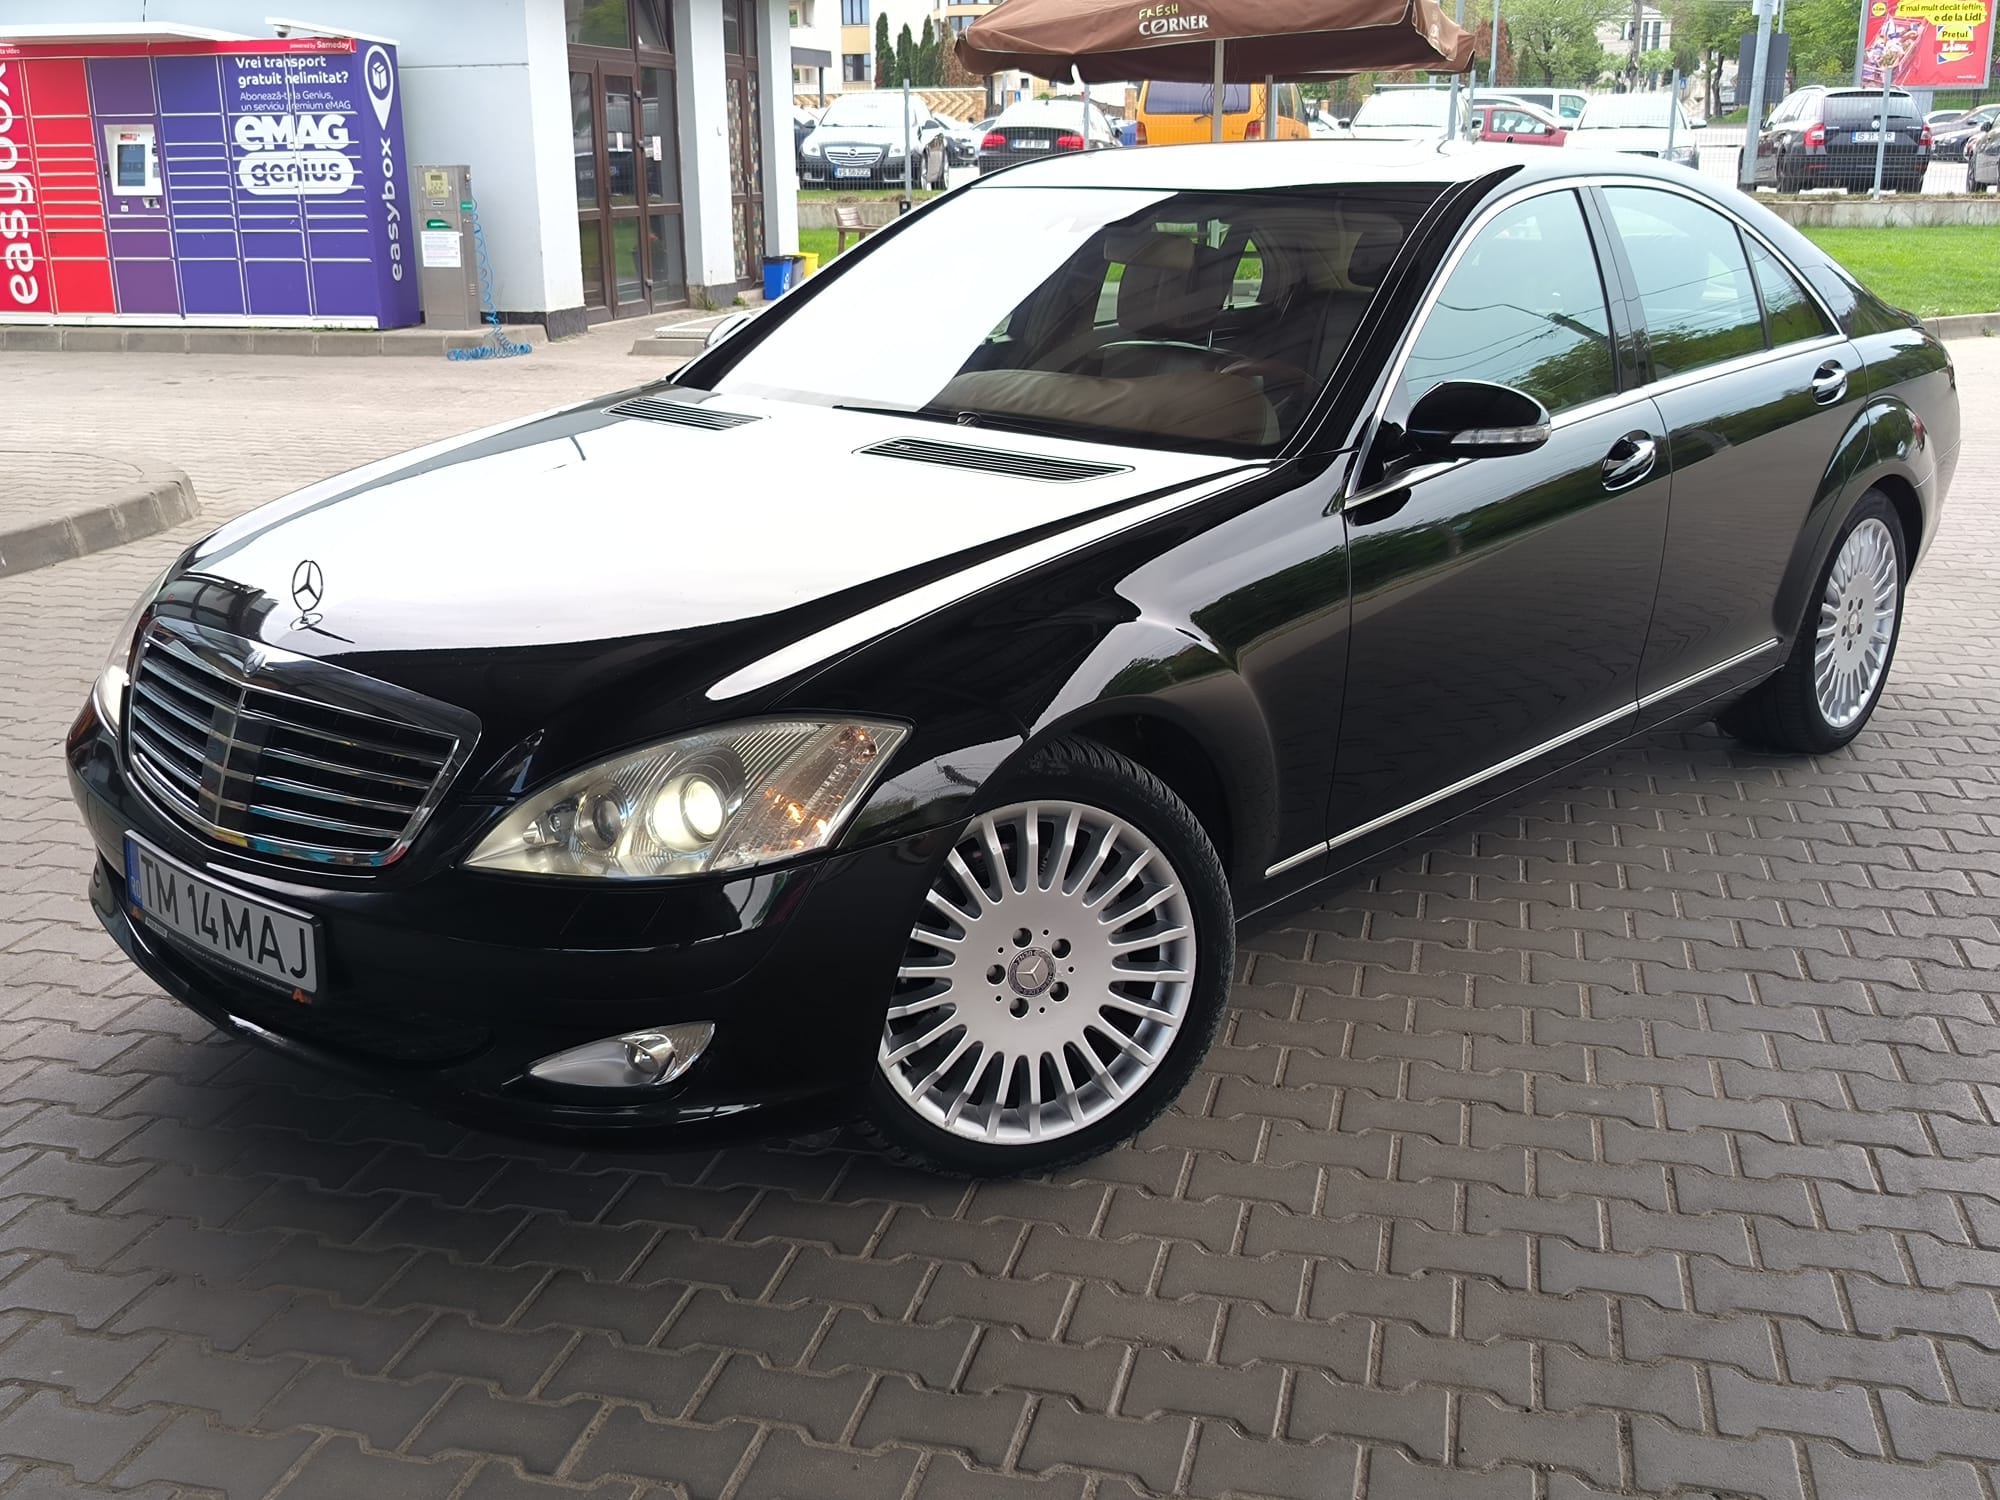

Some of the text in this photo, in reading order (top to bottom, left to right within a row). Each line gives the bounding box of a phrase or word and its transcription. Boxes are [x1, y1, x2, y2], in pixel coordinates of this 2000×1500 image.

[1138, 3, 1179, 20] FRESH
[1964, 12, 1982, 21] Lidl
[1138, 14, 1209, 36] CORNER
[316, 41, 350, 50] Sameday
[235, 56, 326, 70] Vrei transport
[238, 71, 349, 88] gratuit nelimitat?
[302, 90, 334, 101] Genius,
[254, 102, 284, 111] serviciu
[326, 100, 351, 110] eMAG
[234, 114, 350, 150] eMAG
[250, 158, 342, 186] genius
[380, 138, 402, 281] easybox
[140, 854, 180, 925] TM
[188, 884, 308, 979] 14MAJ
